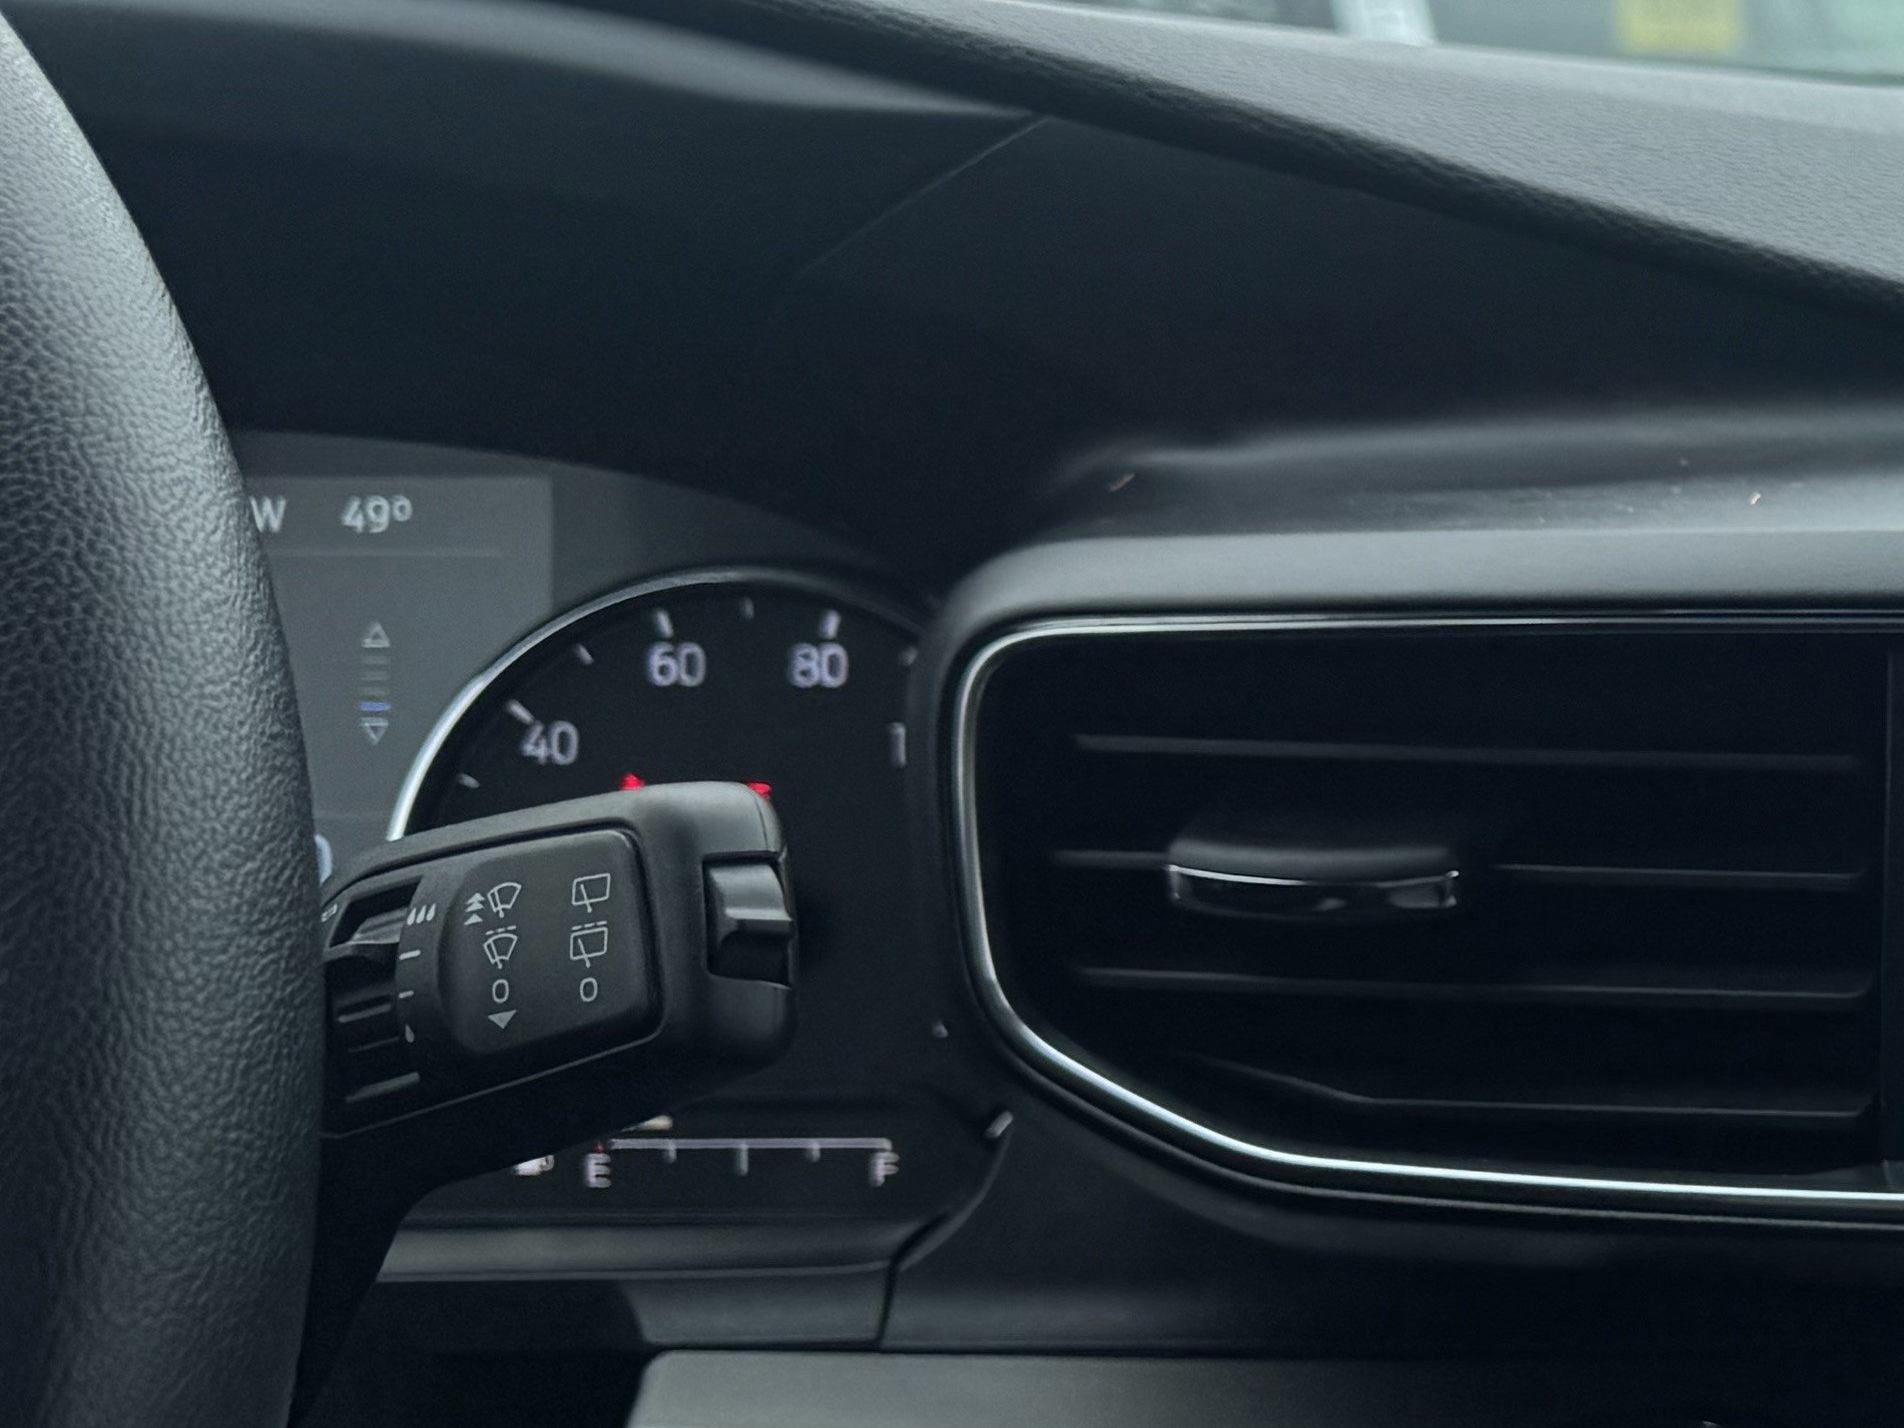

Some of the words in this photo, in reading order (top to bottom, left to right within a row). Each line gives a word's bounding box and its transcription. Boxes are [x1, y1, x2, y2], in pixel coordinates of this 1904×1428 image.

[648, 643, 706, 687] 60
[789, 644, 849, 688] 80
[520, 722, 579, 765] 40
[585, 1152, 612, 1189] E
[870, 1151, 900, 1188] F
